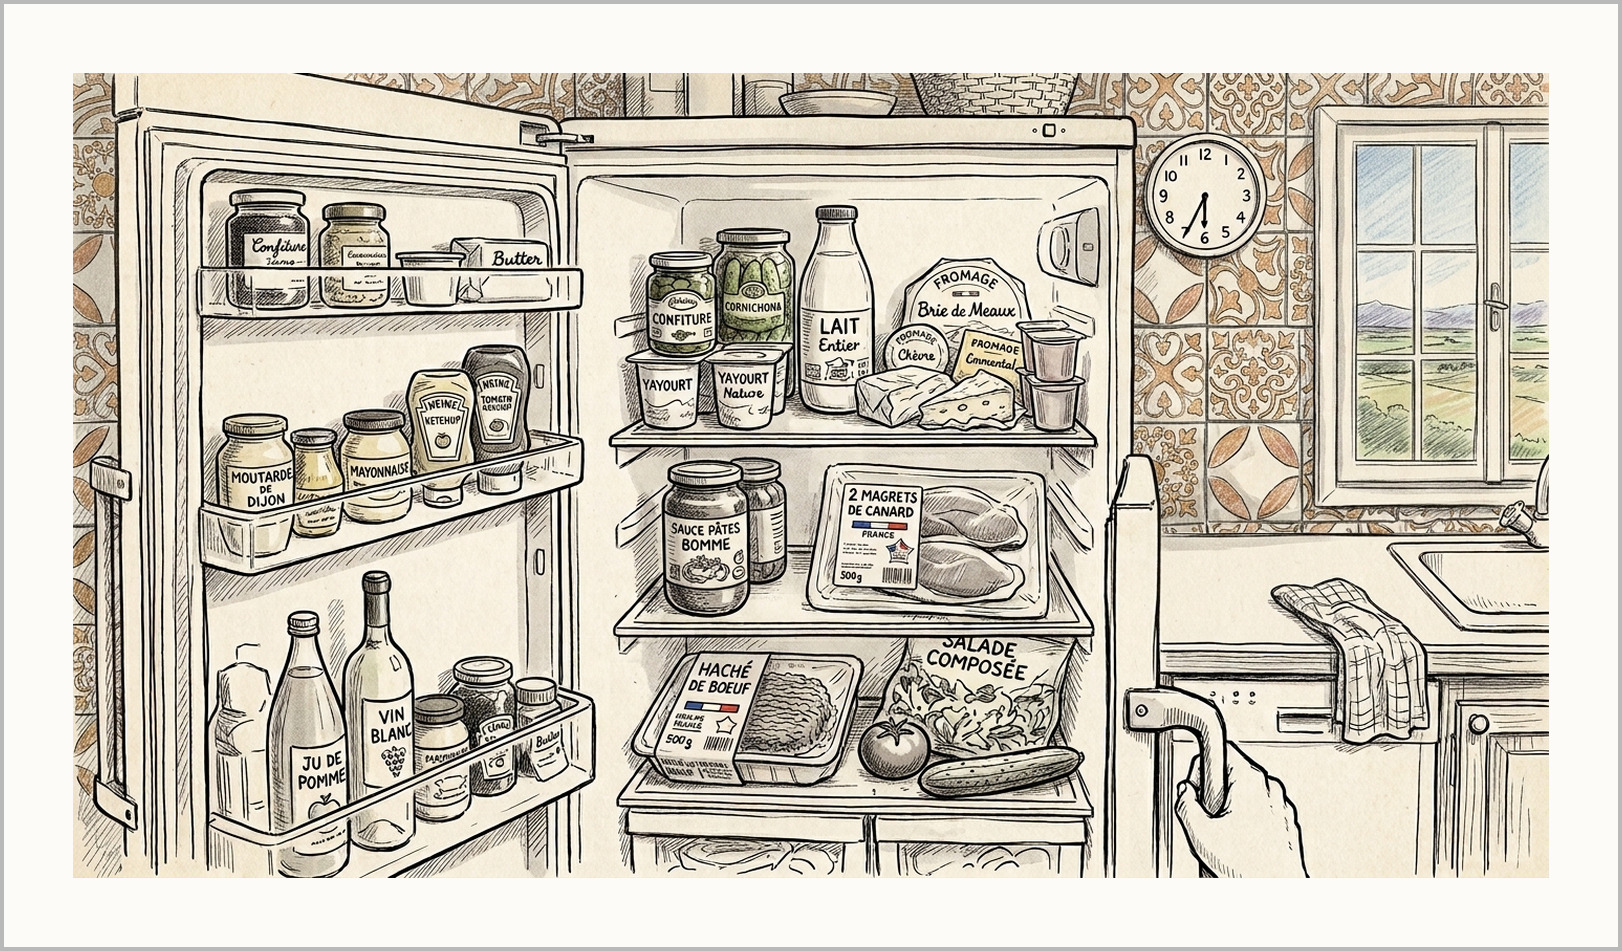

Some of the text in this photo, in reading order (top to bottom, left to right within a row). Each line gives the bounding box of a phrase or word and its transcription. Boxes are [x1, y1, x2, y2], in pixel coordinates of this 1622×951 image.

[1179, 154, 1188, 166] 11
[1199, 148, 1212, 161] 12
[1224, 154, 1228, 166] 1
[1164, 170, 1178, 182] 10
[1237, 167, 1245, 180] 2
[1159, 188, 1168, 203] 9
[1242, 189, 1251, 202] 3
[1165, 210, 1175, 224] 8
[1236, 211, 1246, 224] 4
[1200, 231, 1209, 244] 6
[1221, 225, 1230, 238] 5
[252, 238, 306, 257] Confiture
[491, 250, 543, 266] Butter
[933, 269, 999, 290] FROMAGE
[917, 301, 1016, 318] Brie de Meaux
[652, 312, 712, 326] CONFITURE
[820, 317, 860, 335] LAIT
[818, 337, 860, 352] Entier
[643, 377, 693, 392] YAYOURT
[718, 371, 769, 385] YAYOURT
[232, 467, 293, 484] MOUTARDE
[350, 461, 409, 478] MAYONNAISE
[259, 485, 272, 495] DE
[848, 488, 918, 504] 2 MAGRETS
[247, 493, 286, 508] DIJON
[848, 504, 914, 518] DE CANARD
[671, 521, 741, 536] SAUCE PÂTES
[682, 537, 731, 551] BOMME
[698, 660, 753, 679] HACHÉ
[926, 649, 1028, 681] COMPOSÉE
[688, 680, 752, 695] DE BOEUF
[378, 706, 405, 725] VIN
[371, 722, 412, 744] BLANC
[302, 750, 342, 771] JU DE
[298, 767, 346, 790] POMME
